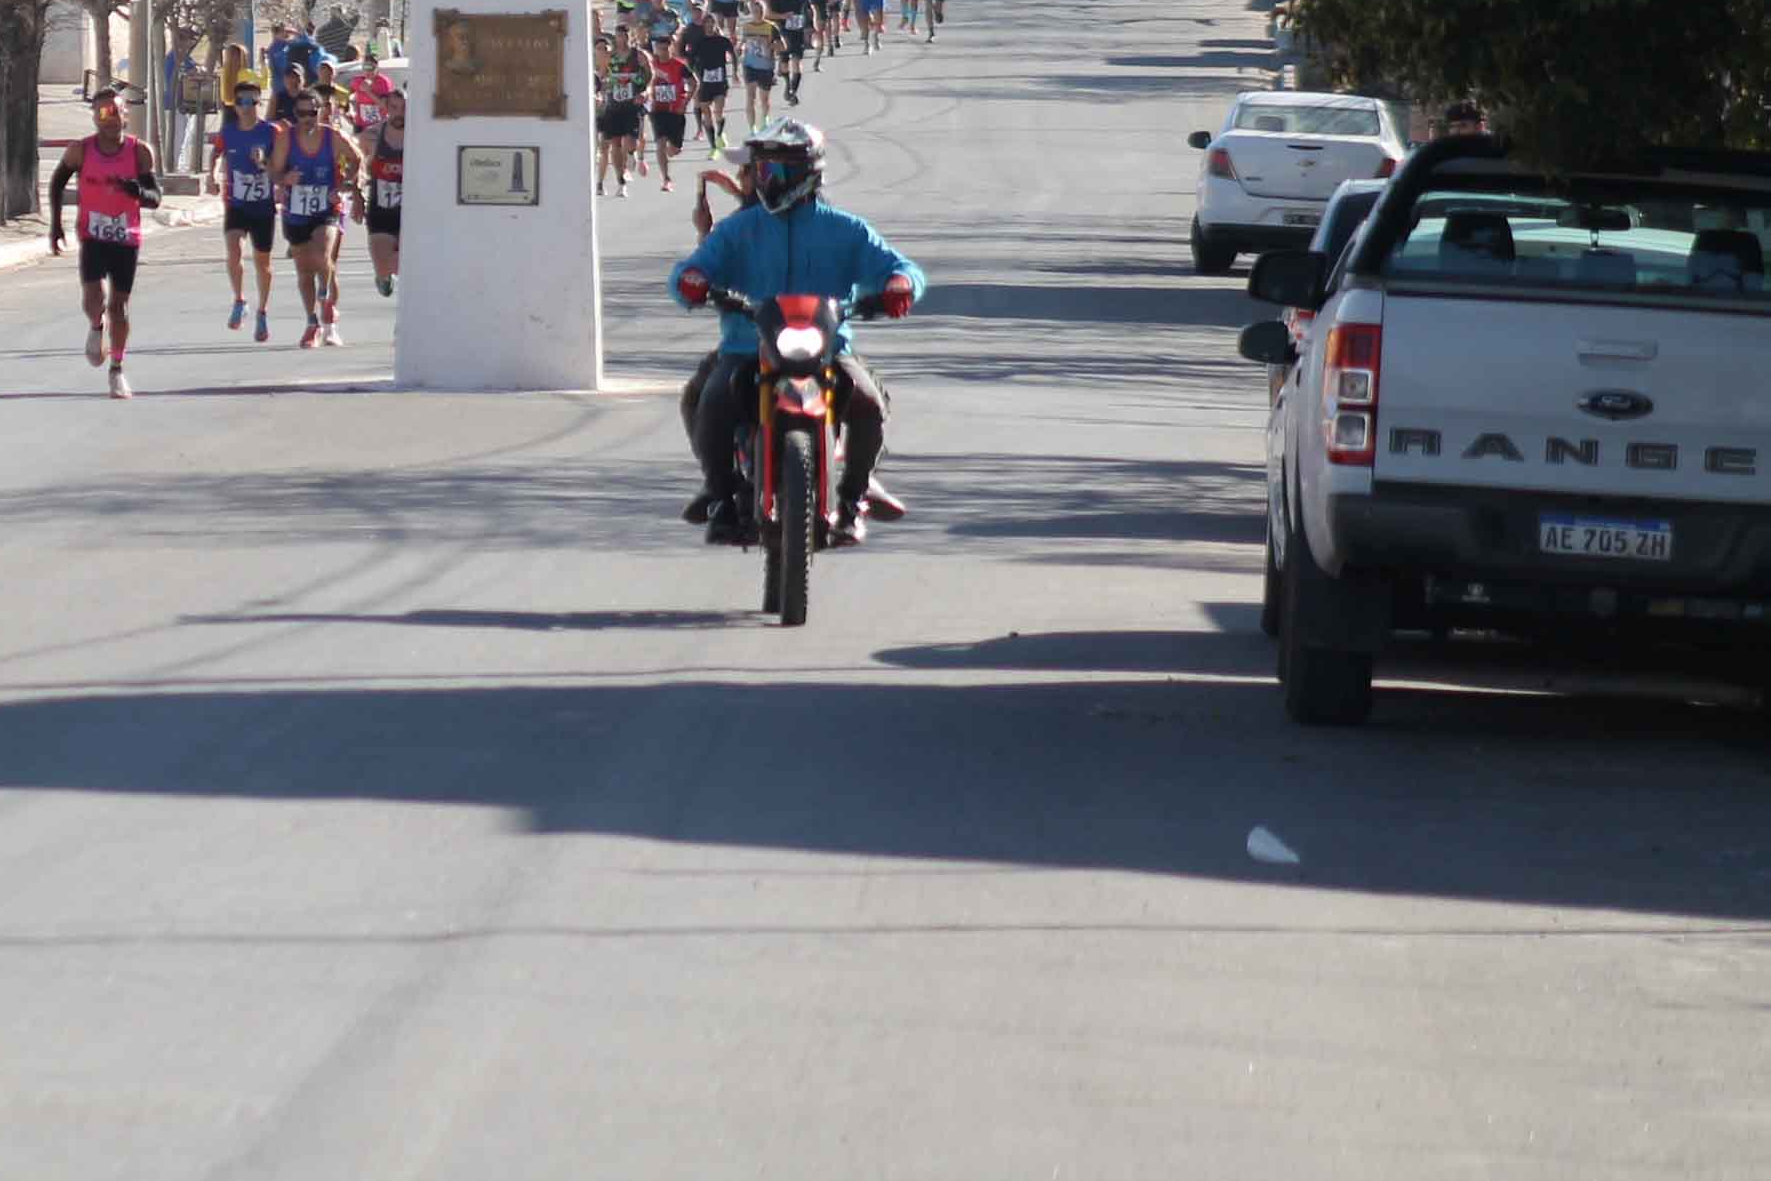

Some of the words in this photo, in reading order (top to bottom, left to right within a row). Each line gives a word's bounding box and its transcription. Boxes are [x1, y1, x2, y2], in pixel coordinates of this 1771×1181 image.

[242, 181, 264, 202] 75
[301, 195, 320, 216] 19
[91, 225, 126, 242] 166
[1545, 526, 1573, 550] AE
[1584, 529, 1628, 554] 705
[1636, 532, 1666, 557] ZH
